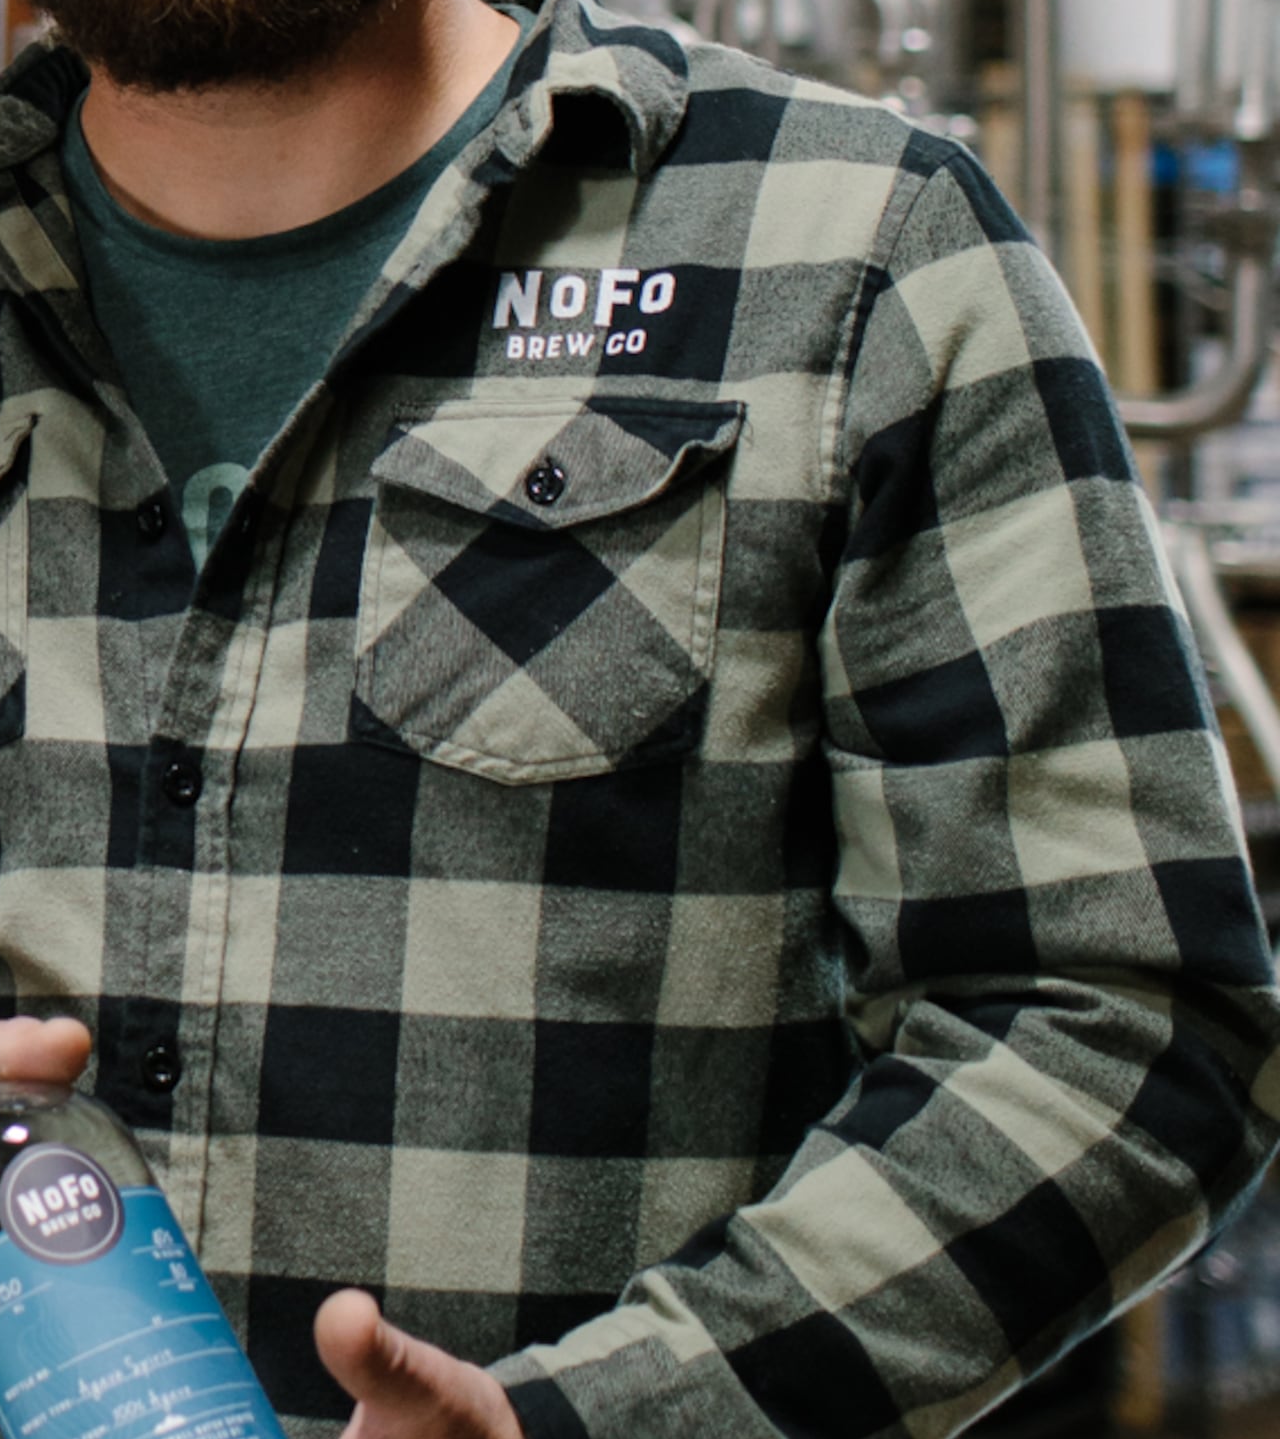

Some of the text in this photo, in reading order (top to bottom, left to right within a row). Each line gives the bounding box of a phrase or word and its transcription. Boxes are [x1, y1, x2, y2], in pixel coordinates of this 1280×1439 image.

[506, 329, 648, 360] BREW CO
[40, 1202, 103, 1238] BREW CO
